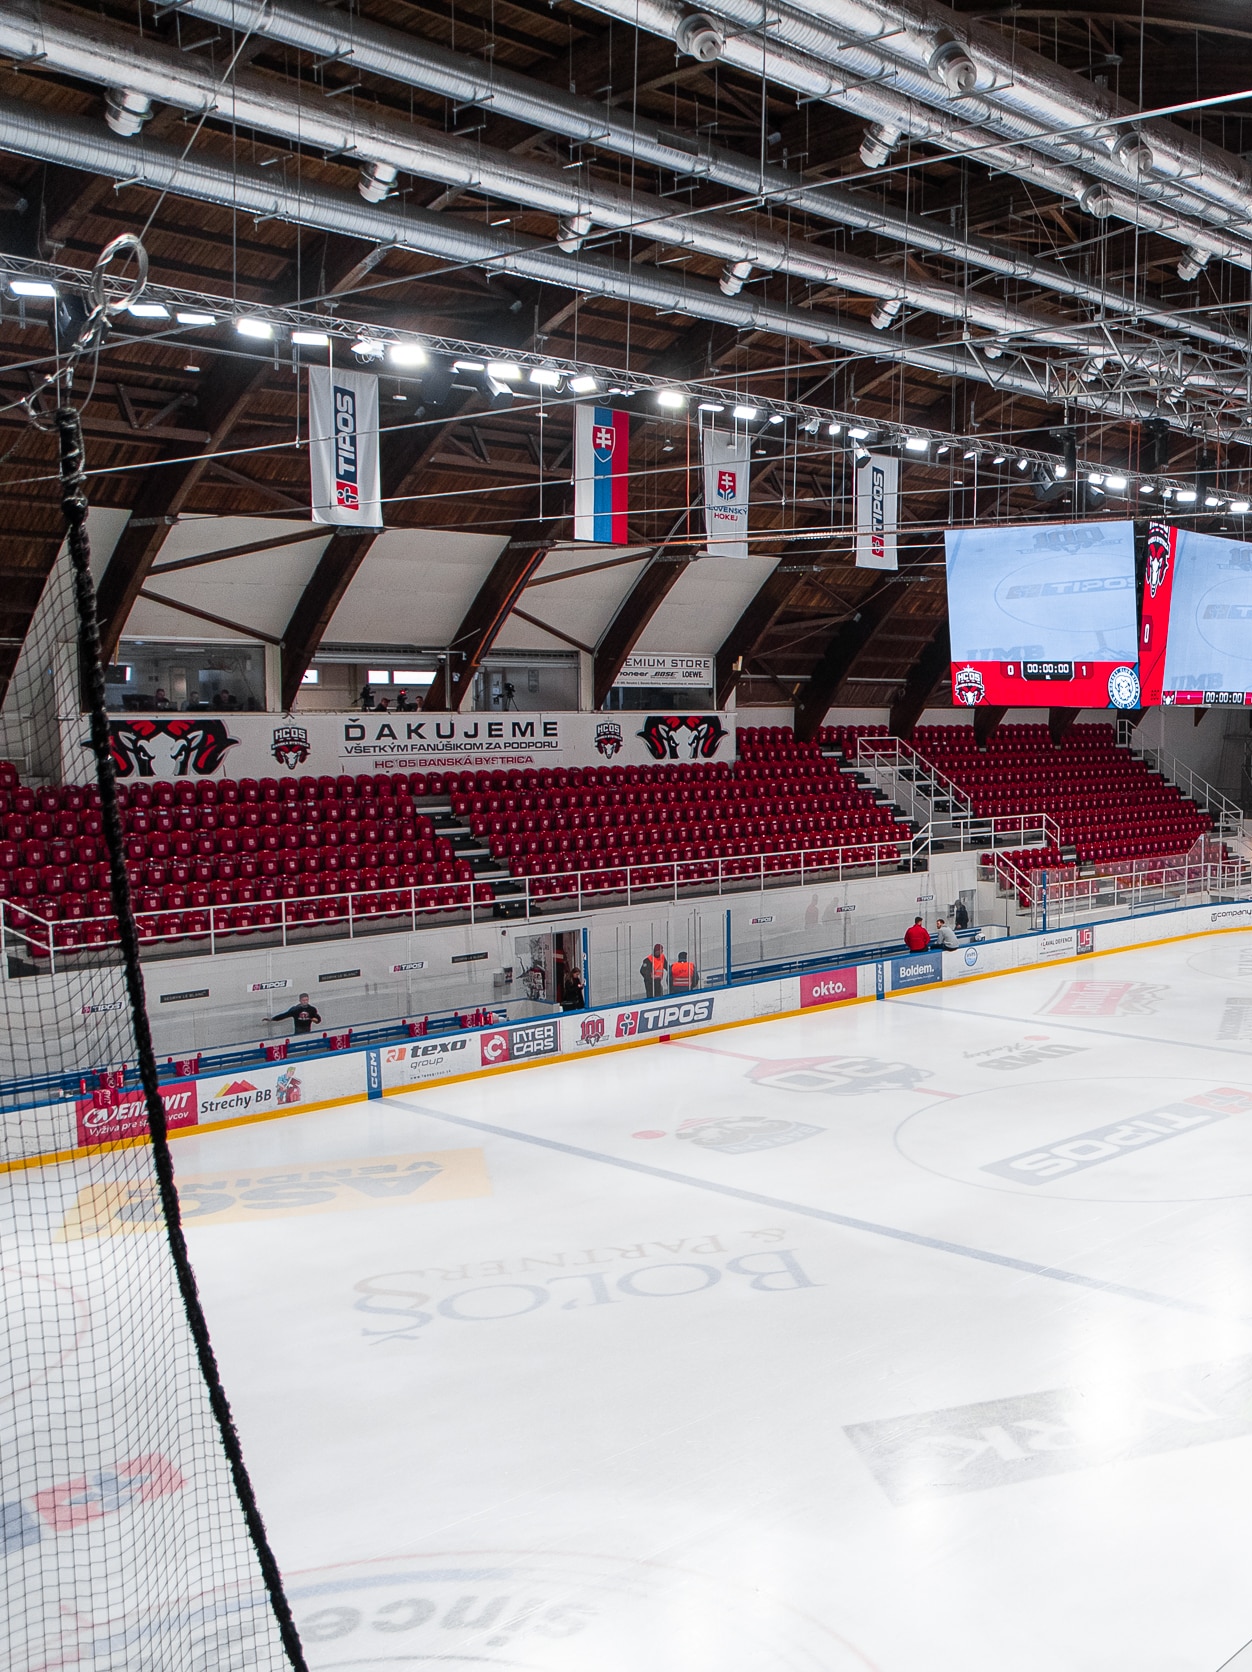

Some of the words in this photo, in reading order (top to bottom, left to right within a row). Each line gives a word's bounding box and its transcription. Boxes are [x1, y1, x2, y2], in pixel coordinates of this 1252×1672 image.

[336, 392, 356, 476] TIPOS
[872, 472, 884, 532] TIPOS
[714, 512, 738, 521] HOKEJ
[625, 657, 666, 667] EMIUM
[671, 659, 710, 668] STORE
[1007, 664, 1015, 675] 0
[1026, 663, 1070, 674] 00:00:00
[1081, 664, 1087, 675] 1
[1205, 691, 1243, 703] 00:00:00
[344, 718, 559, 741] ĎAKUJEME
[344, 740, 409, 754] VŠETKÝM
[410, 740, 484, 753] FANÚŠIKOM
[485, 742, 501, 751] ZA
[503, 740, 559, 750] PODPORU
[374, 759, 392, 769] HC
[419, 755, 473, 767] BANSKÁ
[475, 755, 534, 766] BYSTRICA
[402, 962, 423, 972] TIPOS
[261, 980, 287, 990] TIPOS
[812, 980, 846, 998] okto.
[643, 1001, 710, 1029] TIPOS
[513, 1024, 555, 1045] INTER
[411, 1040, 467, 1058] texo
[513, 1035, 555, 1057] CARS
[370, 1052, 378, 1089] CCM
[410, 1057, 444, 1069] group
[116, 1092, 192, 1120] ENVIT
[200, 1094, 252, 1114] Strechy
[255, 1089, 272, 1101] BB
[121, 1121, 138, 1132] pre
[1007, 1112, 1213, 1177] TIPOS
